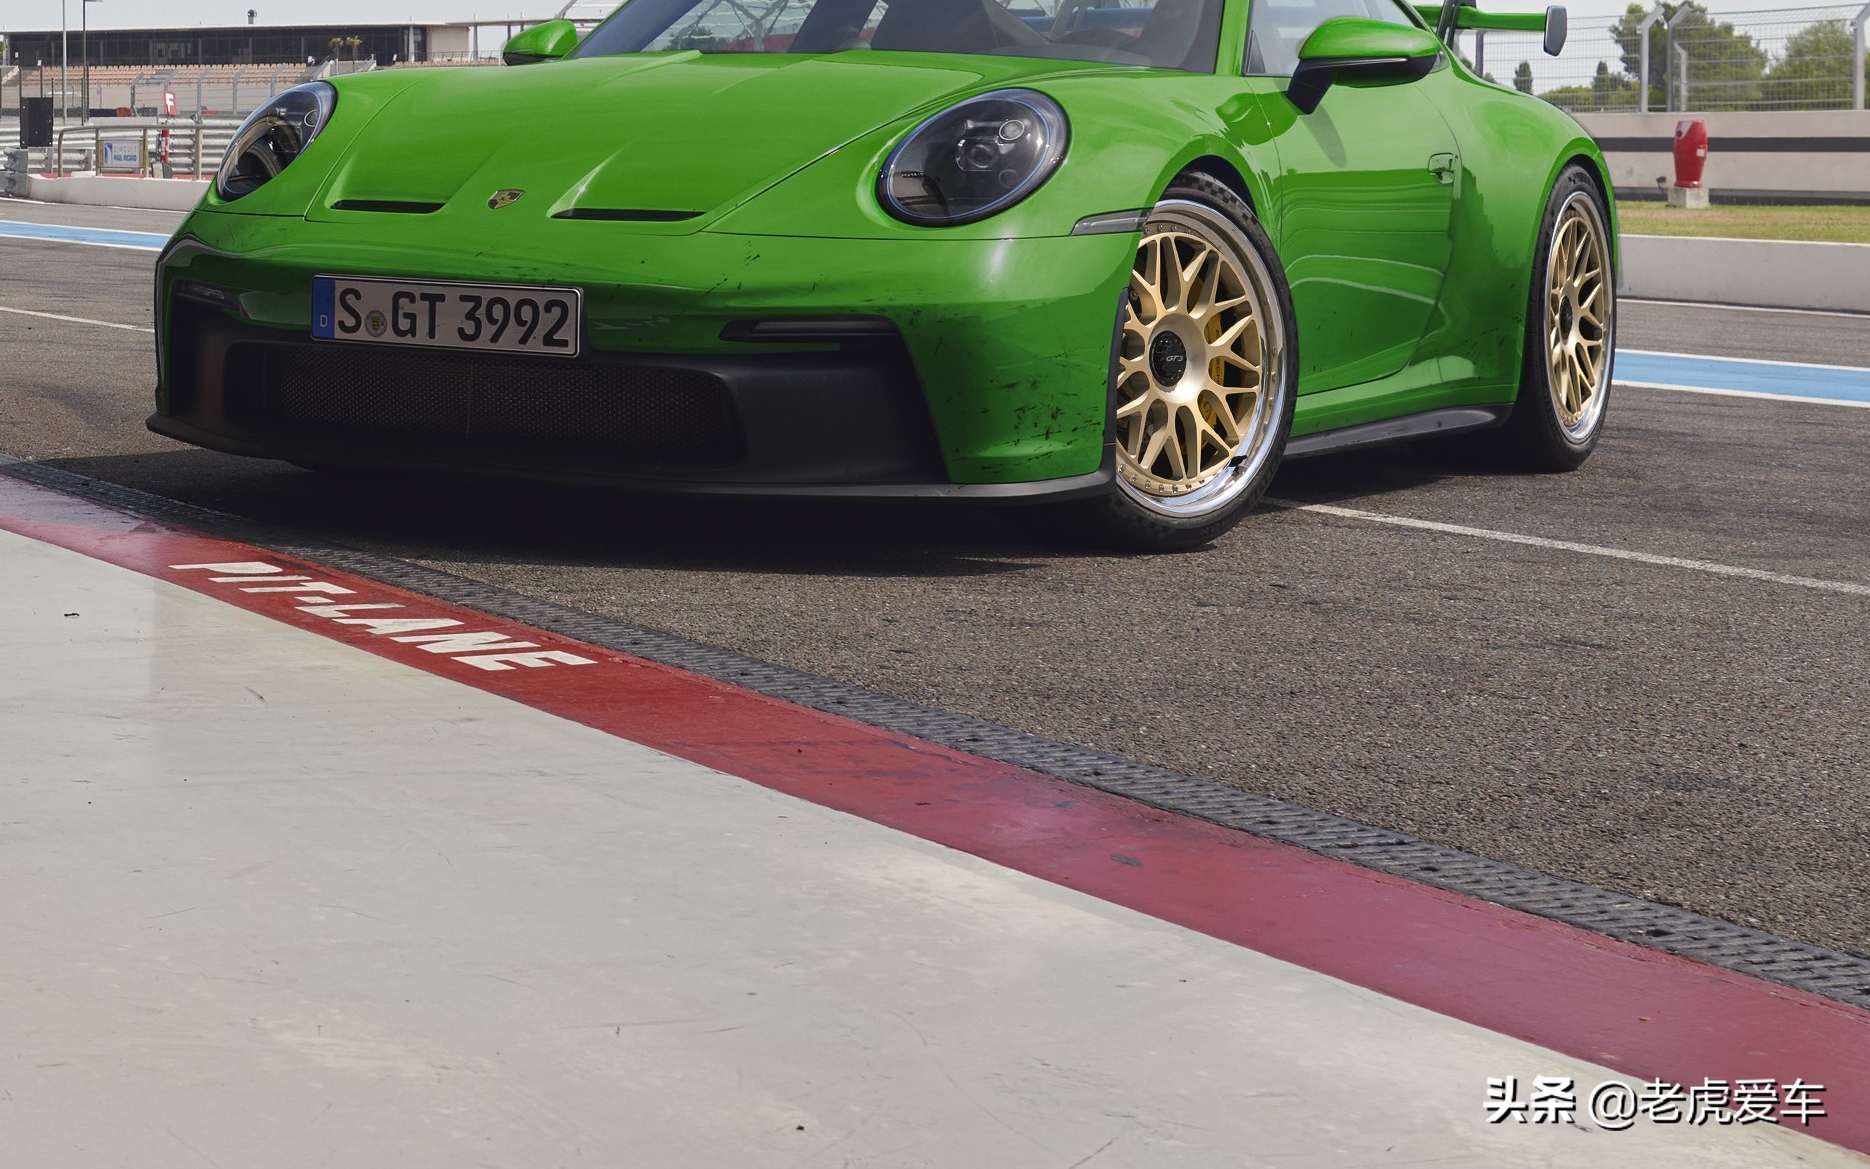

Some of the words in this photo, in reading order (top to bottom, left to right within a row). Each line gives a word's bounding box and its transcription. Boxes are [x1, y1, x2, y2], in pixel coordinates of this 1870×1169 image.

[165, 92, 174, 112] F
[320, 314, 328, 327] D
[337, 288, 362, 334] S
[391, 290, 446, 339] GT
[457, 294, 570, 348] 3992
[168, 561, 598, 671] PIT-LANE
